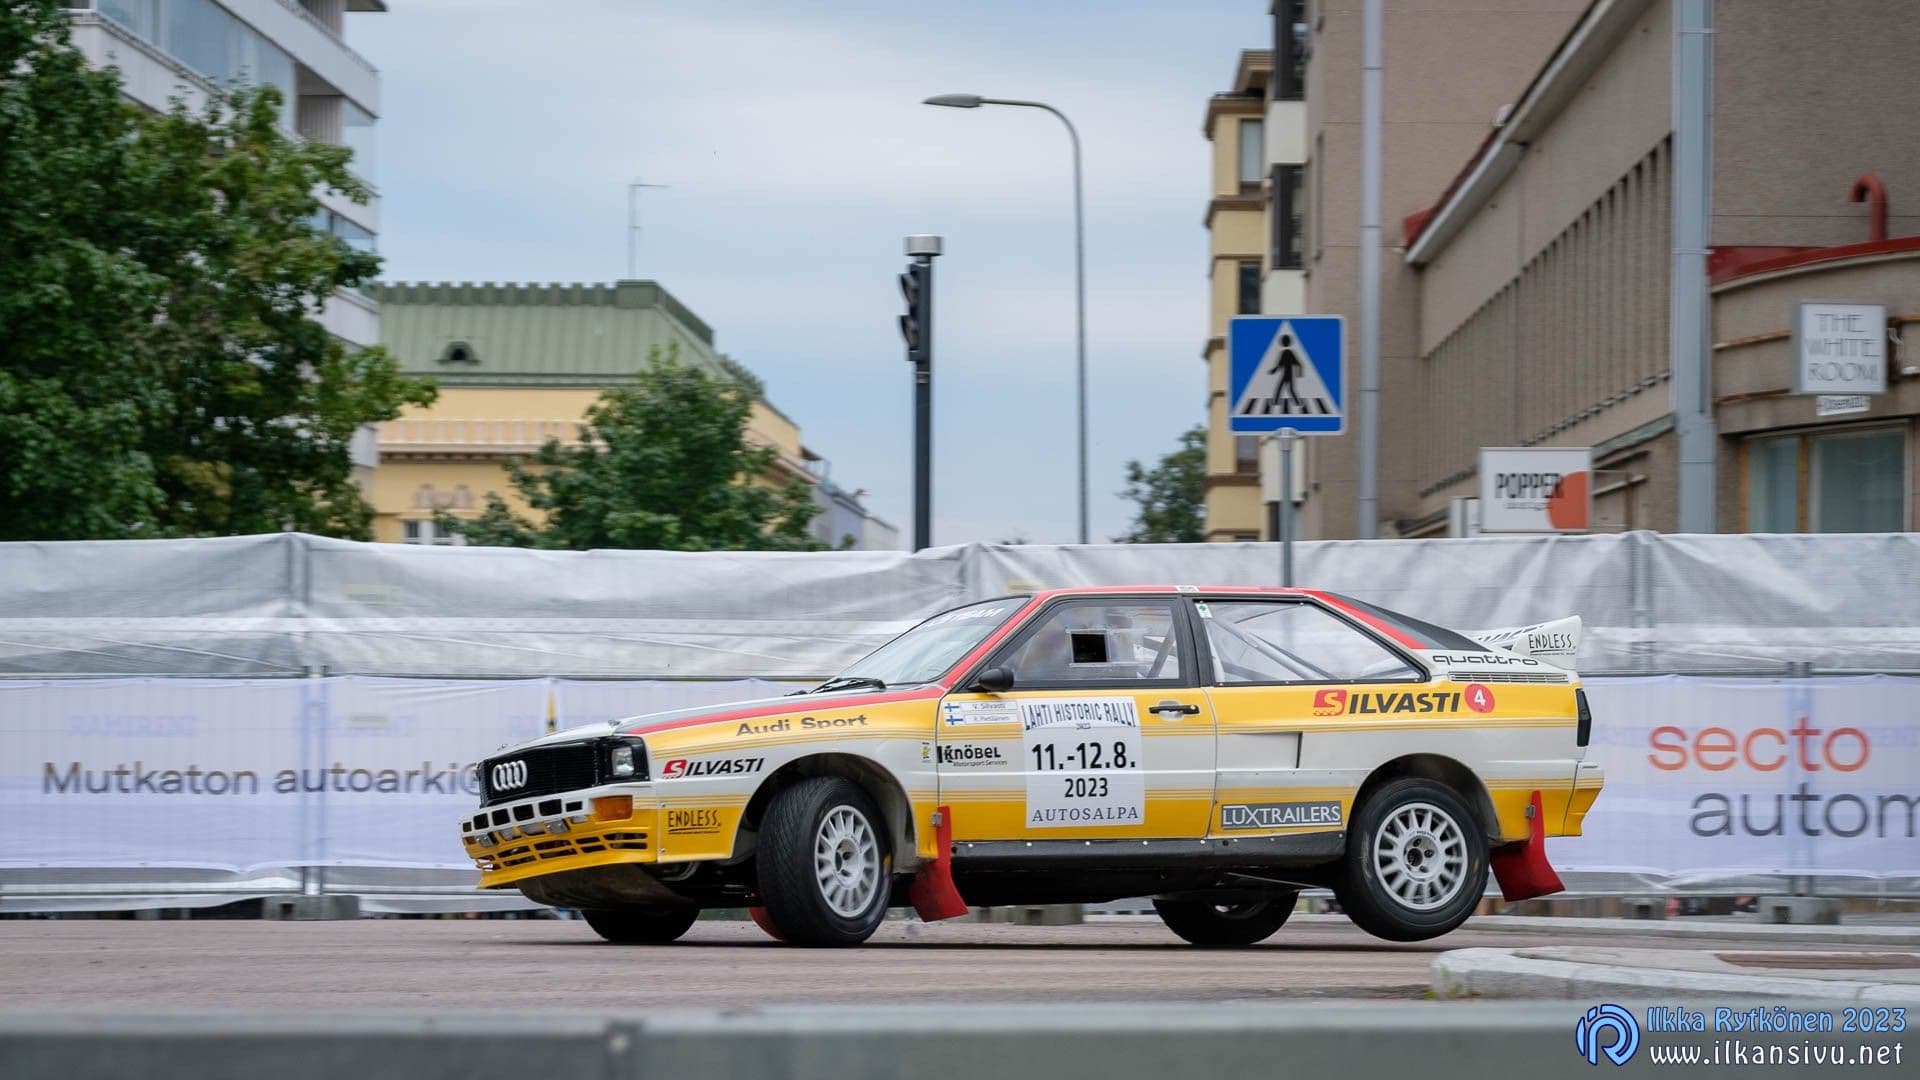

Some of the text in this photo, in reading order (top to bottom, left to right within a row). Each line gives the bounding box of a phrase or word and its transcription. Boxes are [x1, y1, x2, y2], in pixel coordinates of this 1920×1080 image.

[1815, 312, 1866, 333] THE
[1805, 338, 1880, 357] WHITE
[1808, 362, 1878, 382] ROOM
[1495, 472, 1564, 498] POPPER
[1432, 654, 1538, 665] quattro
[1313, 689, 1460, 716] SILVASTI
[1473, 689, 1486, 706] 4
[736, 714, 868, 737] Audi Sport
[1021, 701, 1136, 731] LAHTI HISTORIC RALLY
[1648, 715, 1871, 772] secto
[1032, 741, 1136, 771] 11.-12.8.
[43, 760, 259, 795] Mutkaton
[662, 758, 765, 778] SILVASTI
[1064, 777, 1108, 798] 2023
[1031, 806, 1138, 822] AUTOSALPA
[1222, 805, 1341, 826] LUXTRAILERS
[1689, 782, 1920, 838] autom
